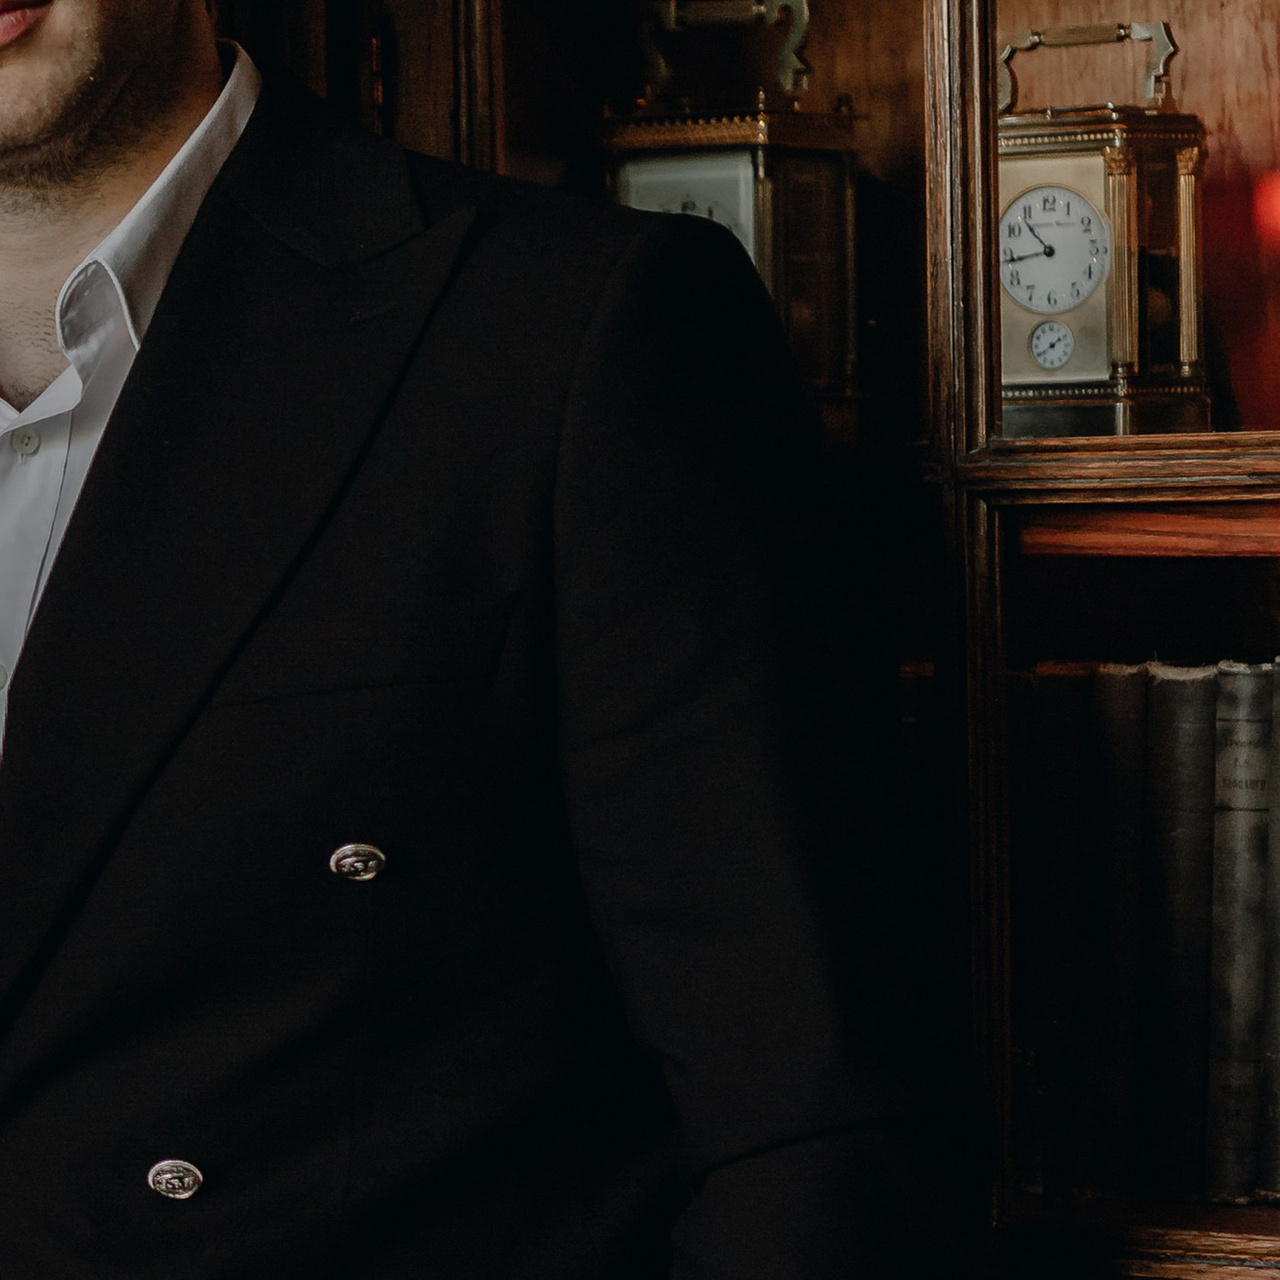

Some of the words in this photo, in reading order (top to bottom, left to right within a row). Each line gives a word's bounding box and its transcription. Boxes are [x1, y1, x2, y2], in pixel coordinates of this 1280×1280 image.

[1042, 195, 1056, 212] 12
[1066, 200, 1071, 216] 1
[1023, 204, 1032, 220] 11
[1007, 222, 1022, 238] 10
[1080, 216, 1092, 233] 2
[1003, 246, 1016, 262] 9
[1010, 269, 1021, 286] 8
[1025, 284, 1035, 302] 7
[1071, 281, 1080, 298] 5
[1047, 290, 1057, 306] 6
